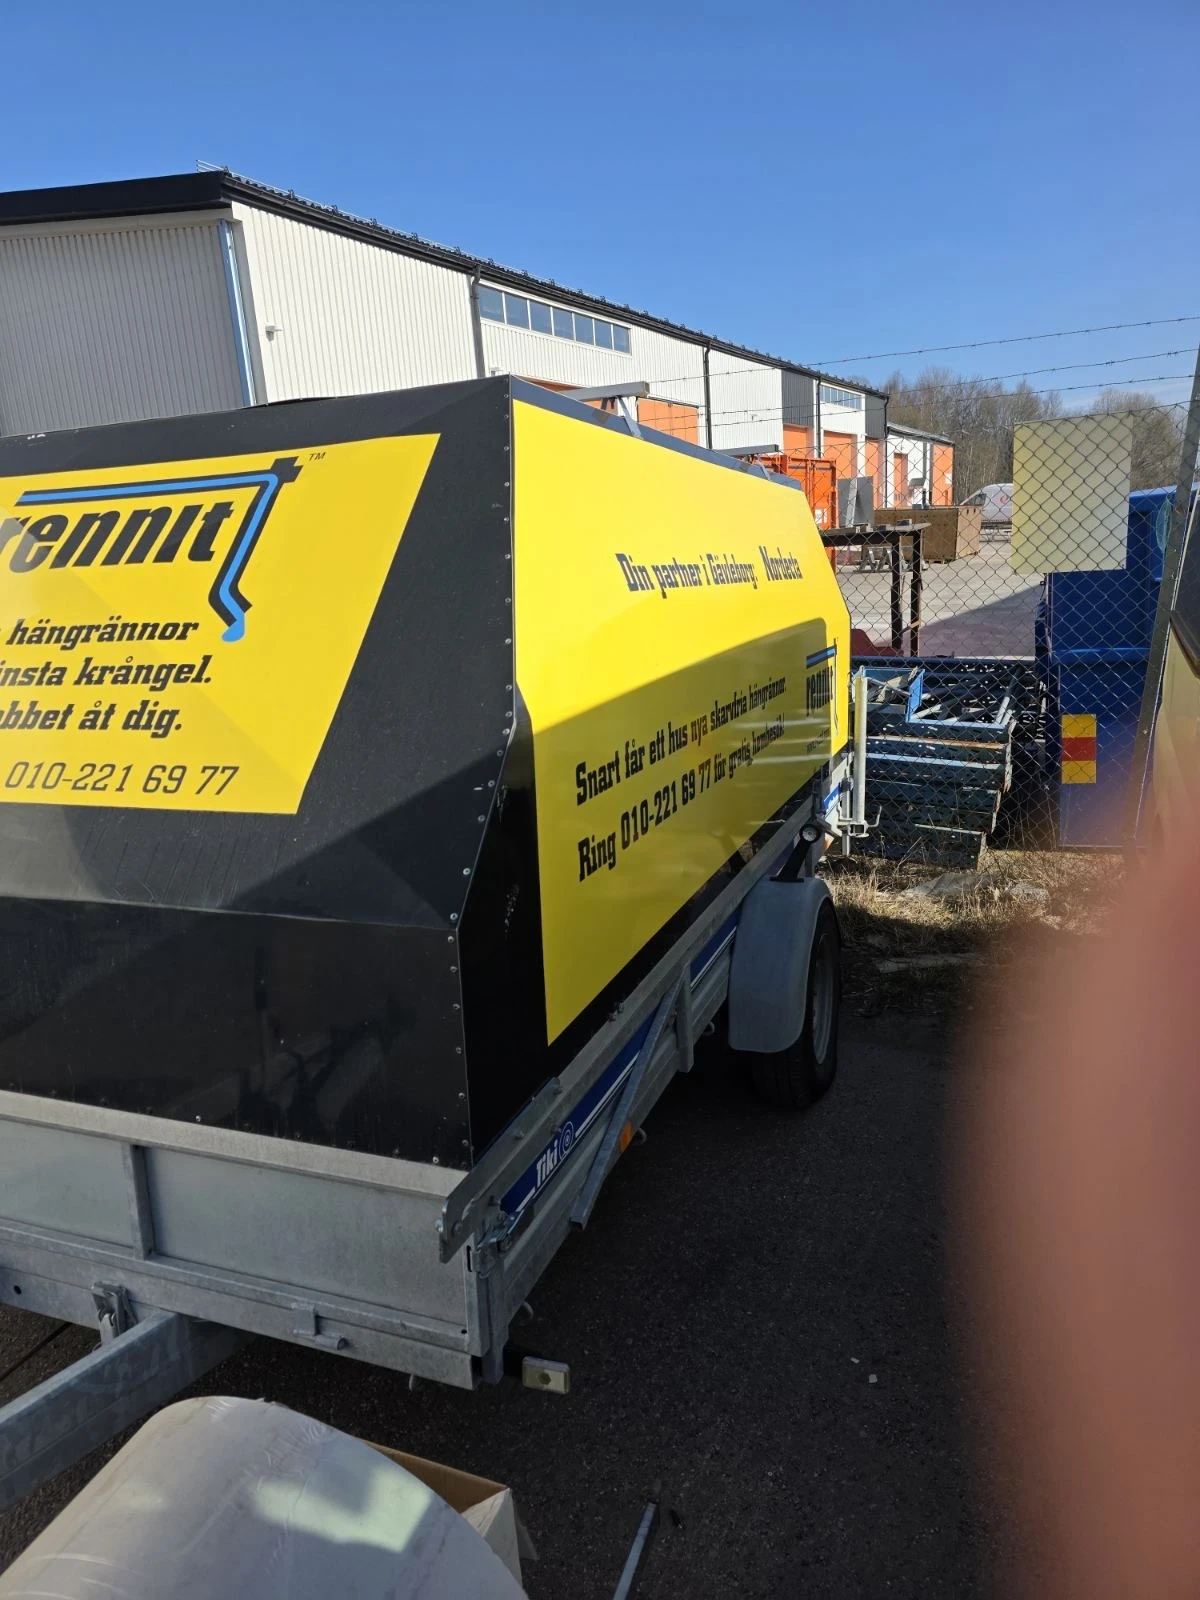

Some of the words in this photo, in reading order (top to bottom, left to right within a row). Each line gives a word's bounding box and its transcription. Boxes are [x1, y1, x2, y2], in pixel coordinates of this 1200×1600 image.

[615, 553, 655, 592] Din
[651, 557, 702, 599] partner
[700, 555, 711, 586] i
[6, 615, 199, 650] hängrännor
[73, 654, 212, 691] krångel.
[0, 700, 75, 730] bbet
[78, 700, 117, 730] åt
[121, 700, 182, 739] dig.
[5, 761, 134, 792] 010-221
[142, 764, 187, 794] 69
[194, 765, 239, 796] 77
[575, 751, 621, 806] Snart
[624, 738, 645, 778] får
[649, 733, 666, 766] ett
[668, 721, 688, 754] hus
[691, 713, 708, 747] nya
[578, 828, 617, 882] Ring
[620, 780, 678, 850] 010-221
[682, 769, 696, 804] 69
[698, 758, 711, 794] 77
[714, 752, 727, 784] för
[536, 1139, 558, 1188] Tiki
